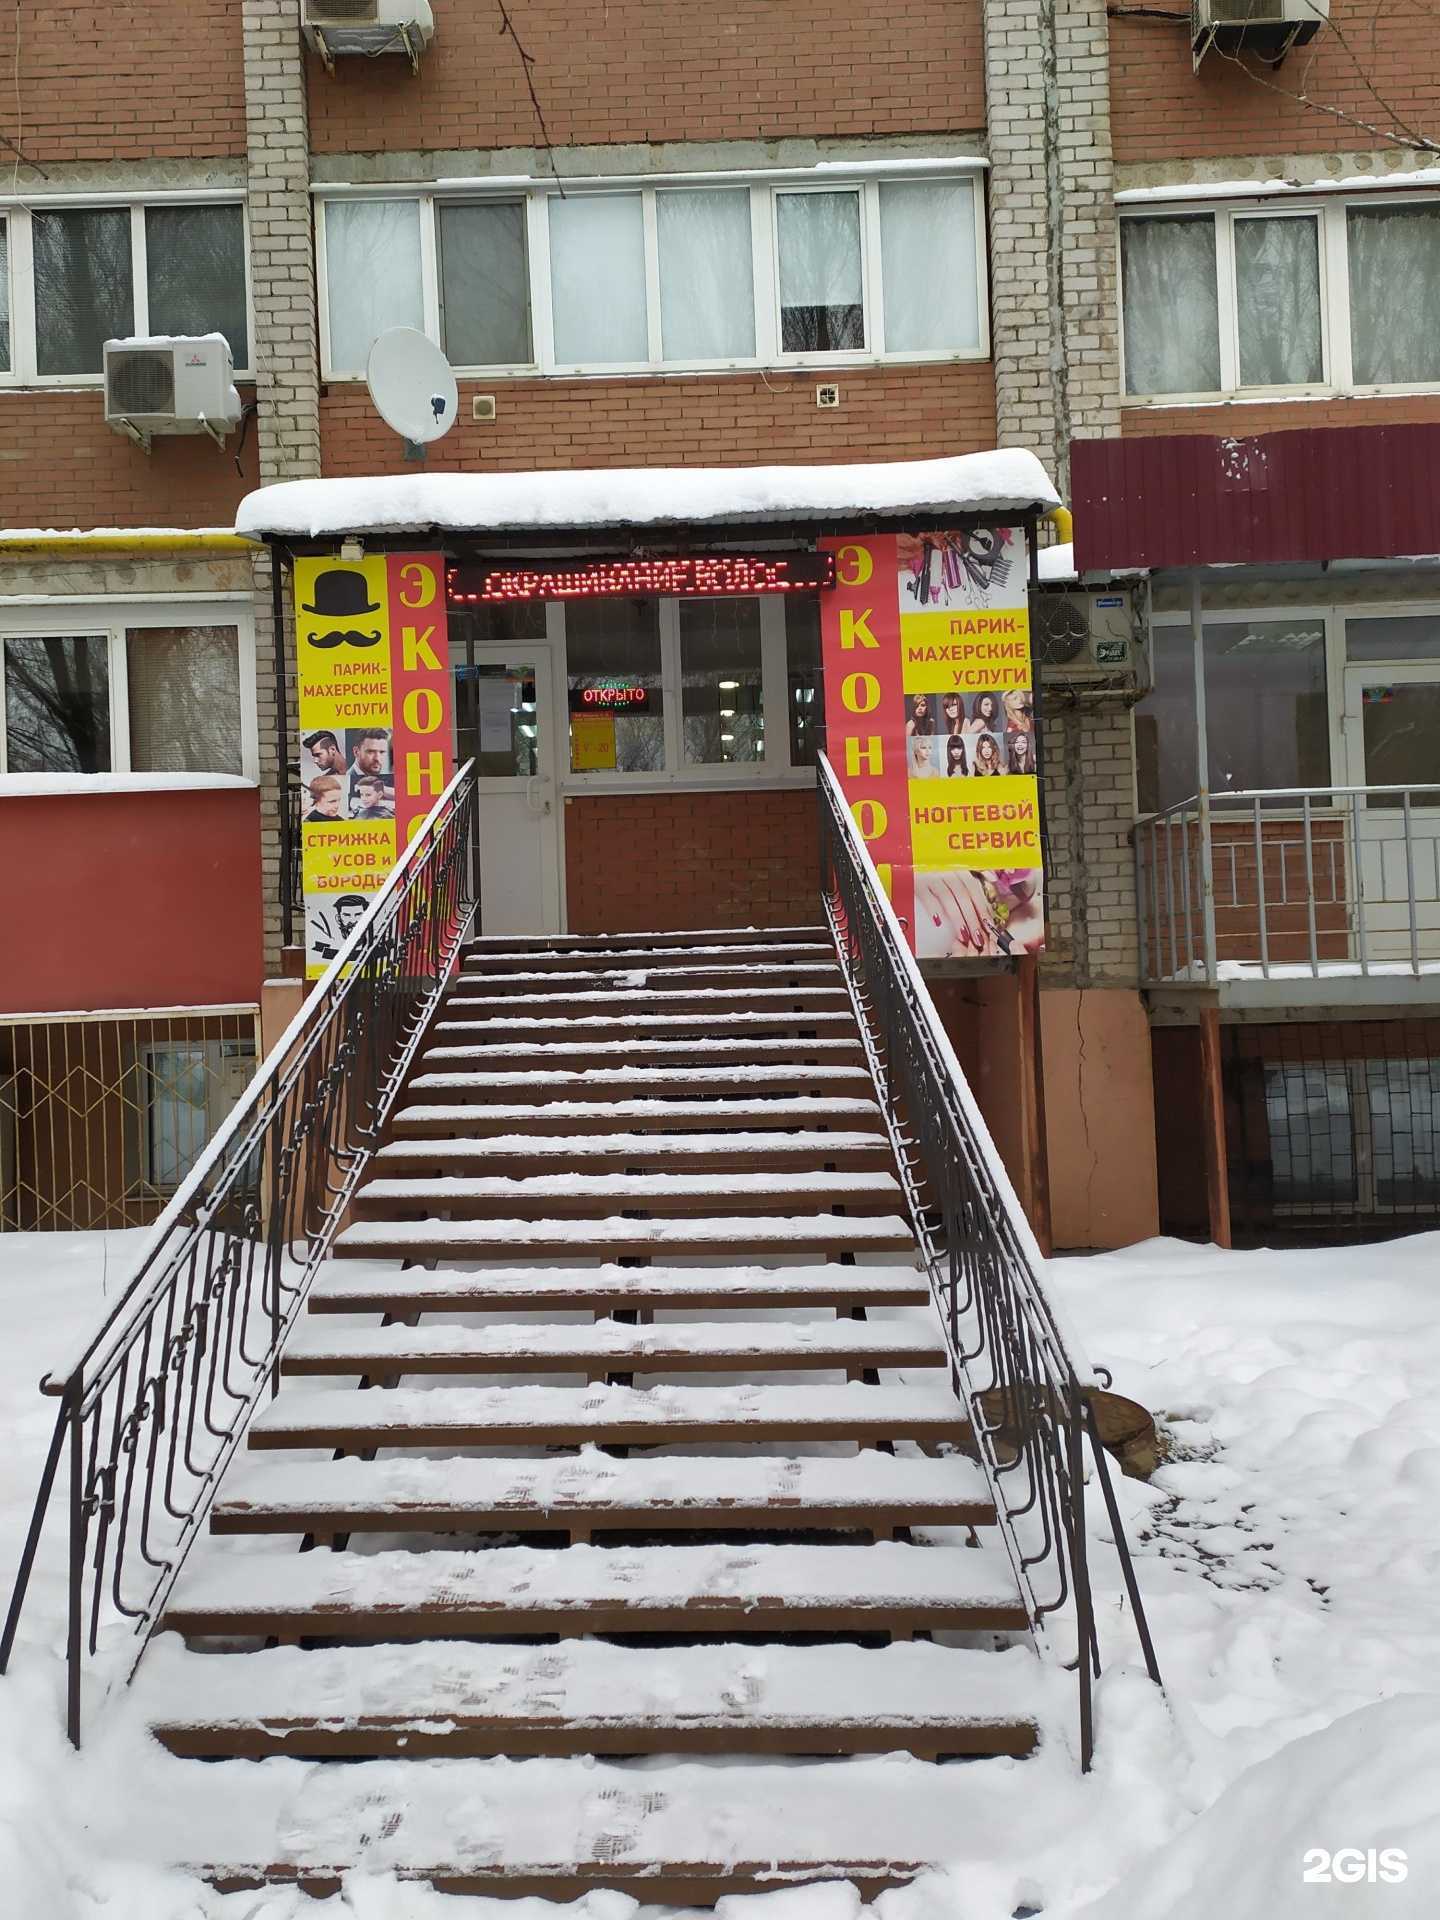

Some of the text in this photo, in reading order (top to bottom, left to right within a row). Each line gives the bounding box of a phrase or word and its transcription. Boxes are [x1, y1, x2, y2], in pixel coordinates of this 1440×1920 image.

[486, 565, 687, 597] ОКРАШИВАНИЕ
[949, 617, 1025, 636] ПАРИК-
[908, 641, 1026, 663] МАХЕРСКИЕ
[332, 661, 388, 677] ПАРИК-
[952, 667, 1027, 686] УСЛУГИ
[303, 682, 388, 698] МАХЕРСКИЕ
[583, 688, 645, 702] ОТКРЫТО
[334, 701, 389, 717] УСЛУГИ
[837, 545, 893, 901] ЭКОНО
[914, 800, 1034, 824] НОГТЕВОЙ
[307, 832, 391, 848] СТРИЖКА
[947, 831, 1036, 850] СЕРВИС
[333, 853, 391, 867] УСОВ и
